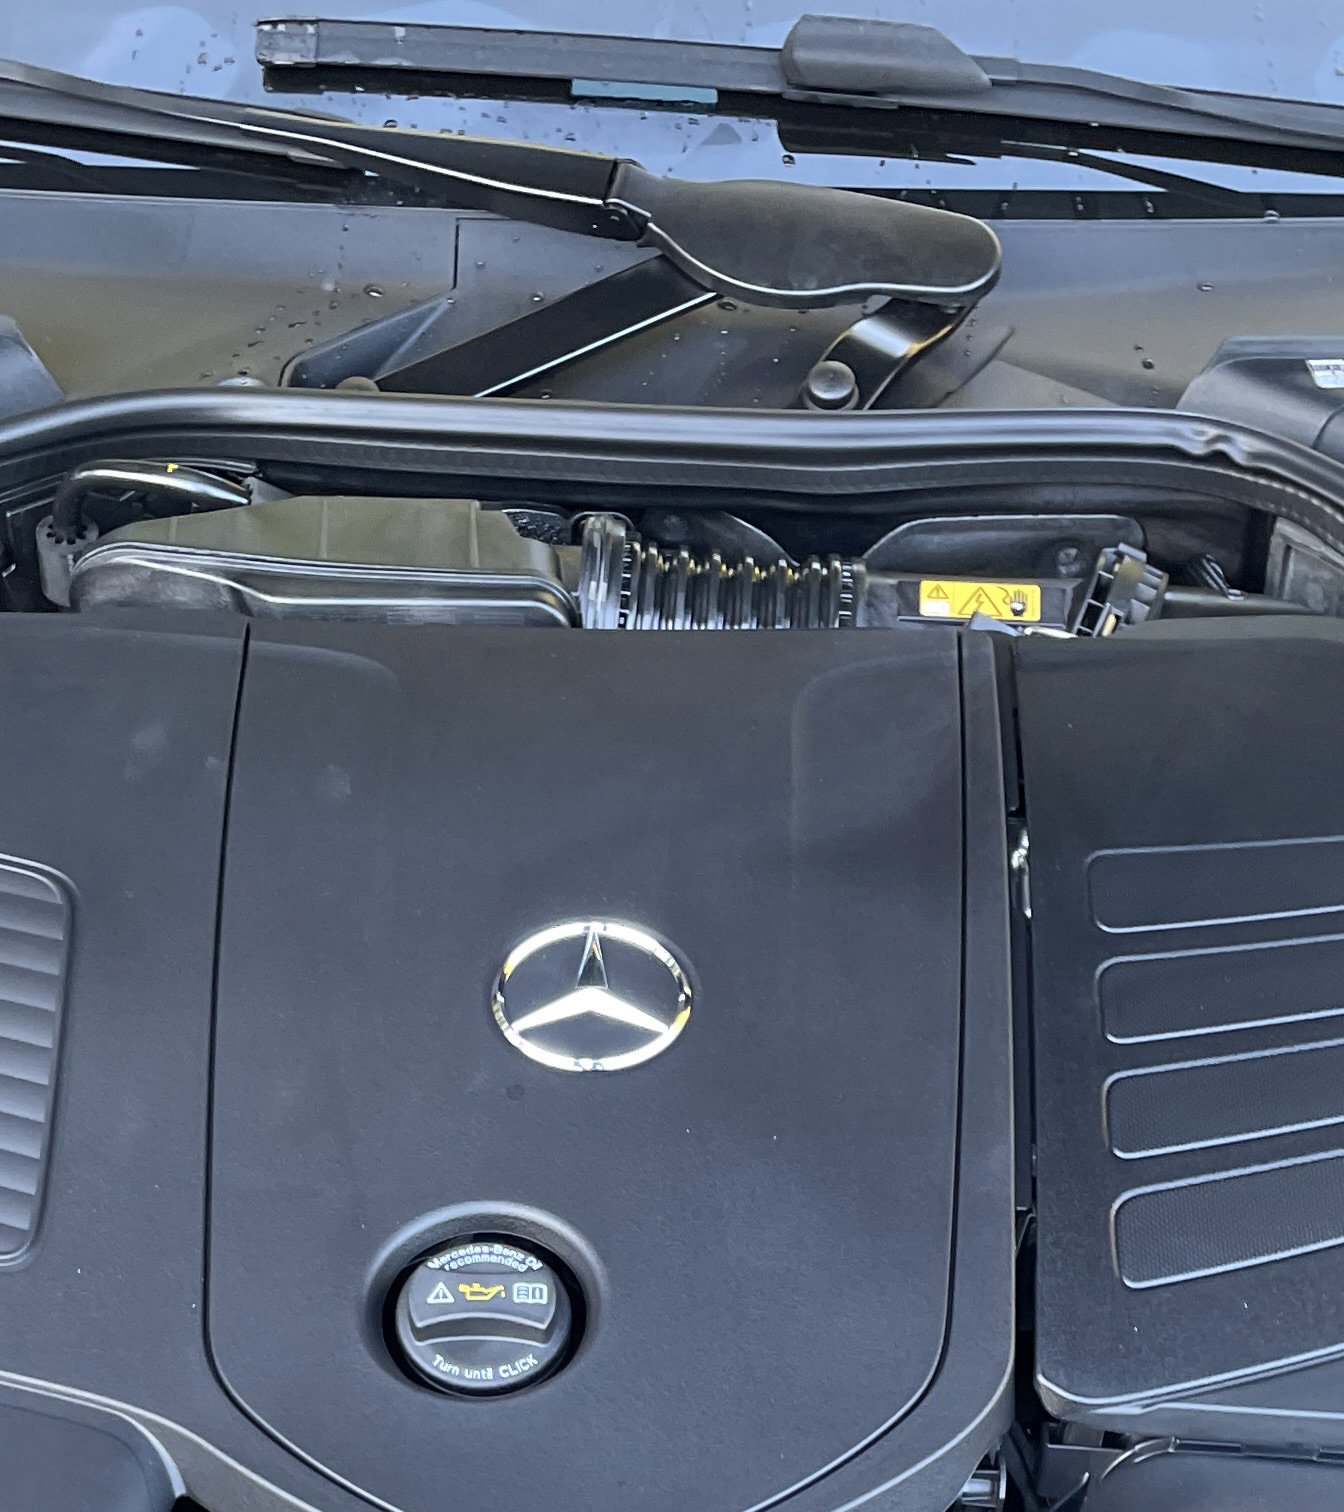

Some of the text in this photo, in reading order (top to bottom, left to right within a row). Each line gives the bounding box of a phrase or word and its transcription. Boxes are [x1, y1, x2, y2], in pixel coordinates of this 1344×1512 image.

[427, 1244, 525, 1269] Mercedes-Benz
[444, 1254, 528, 1273] recommended
[432, 1353, 539, 1380] Turn until CLICK
